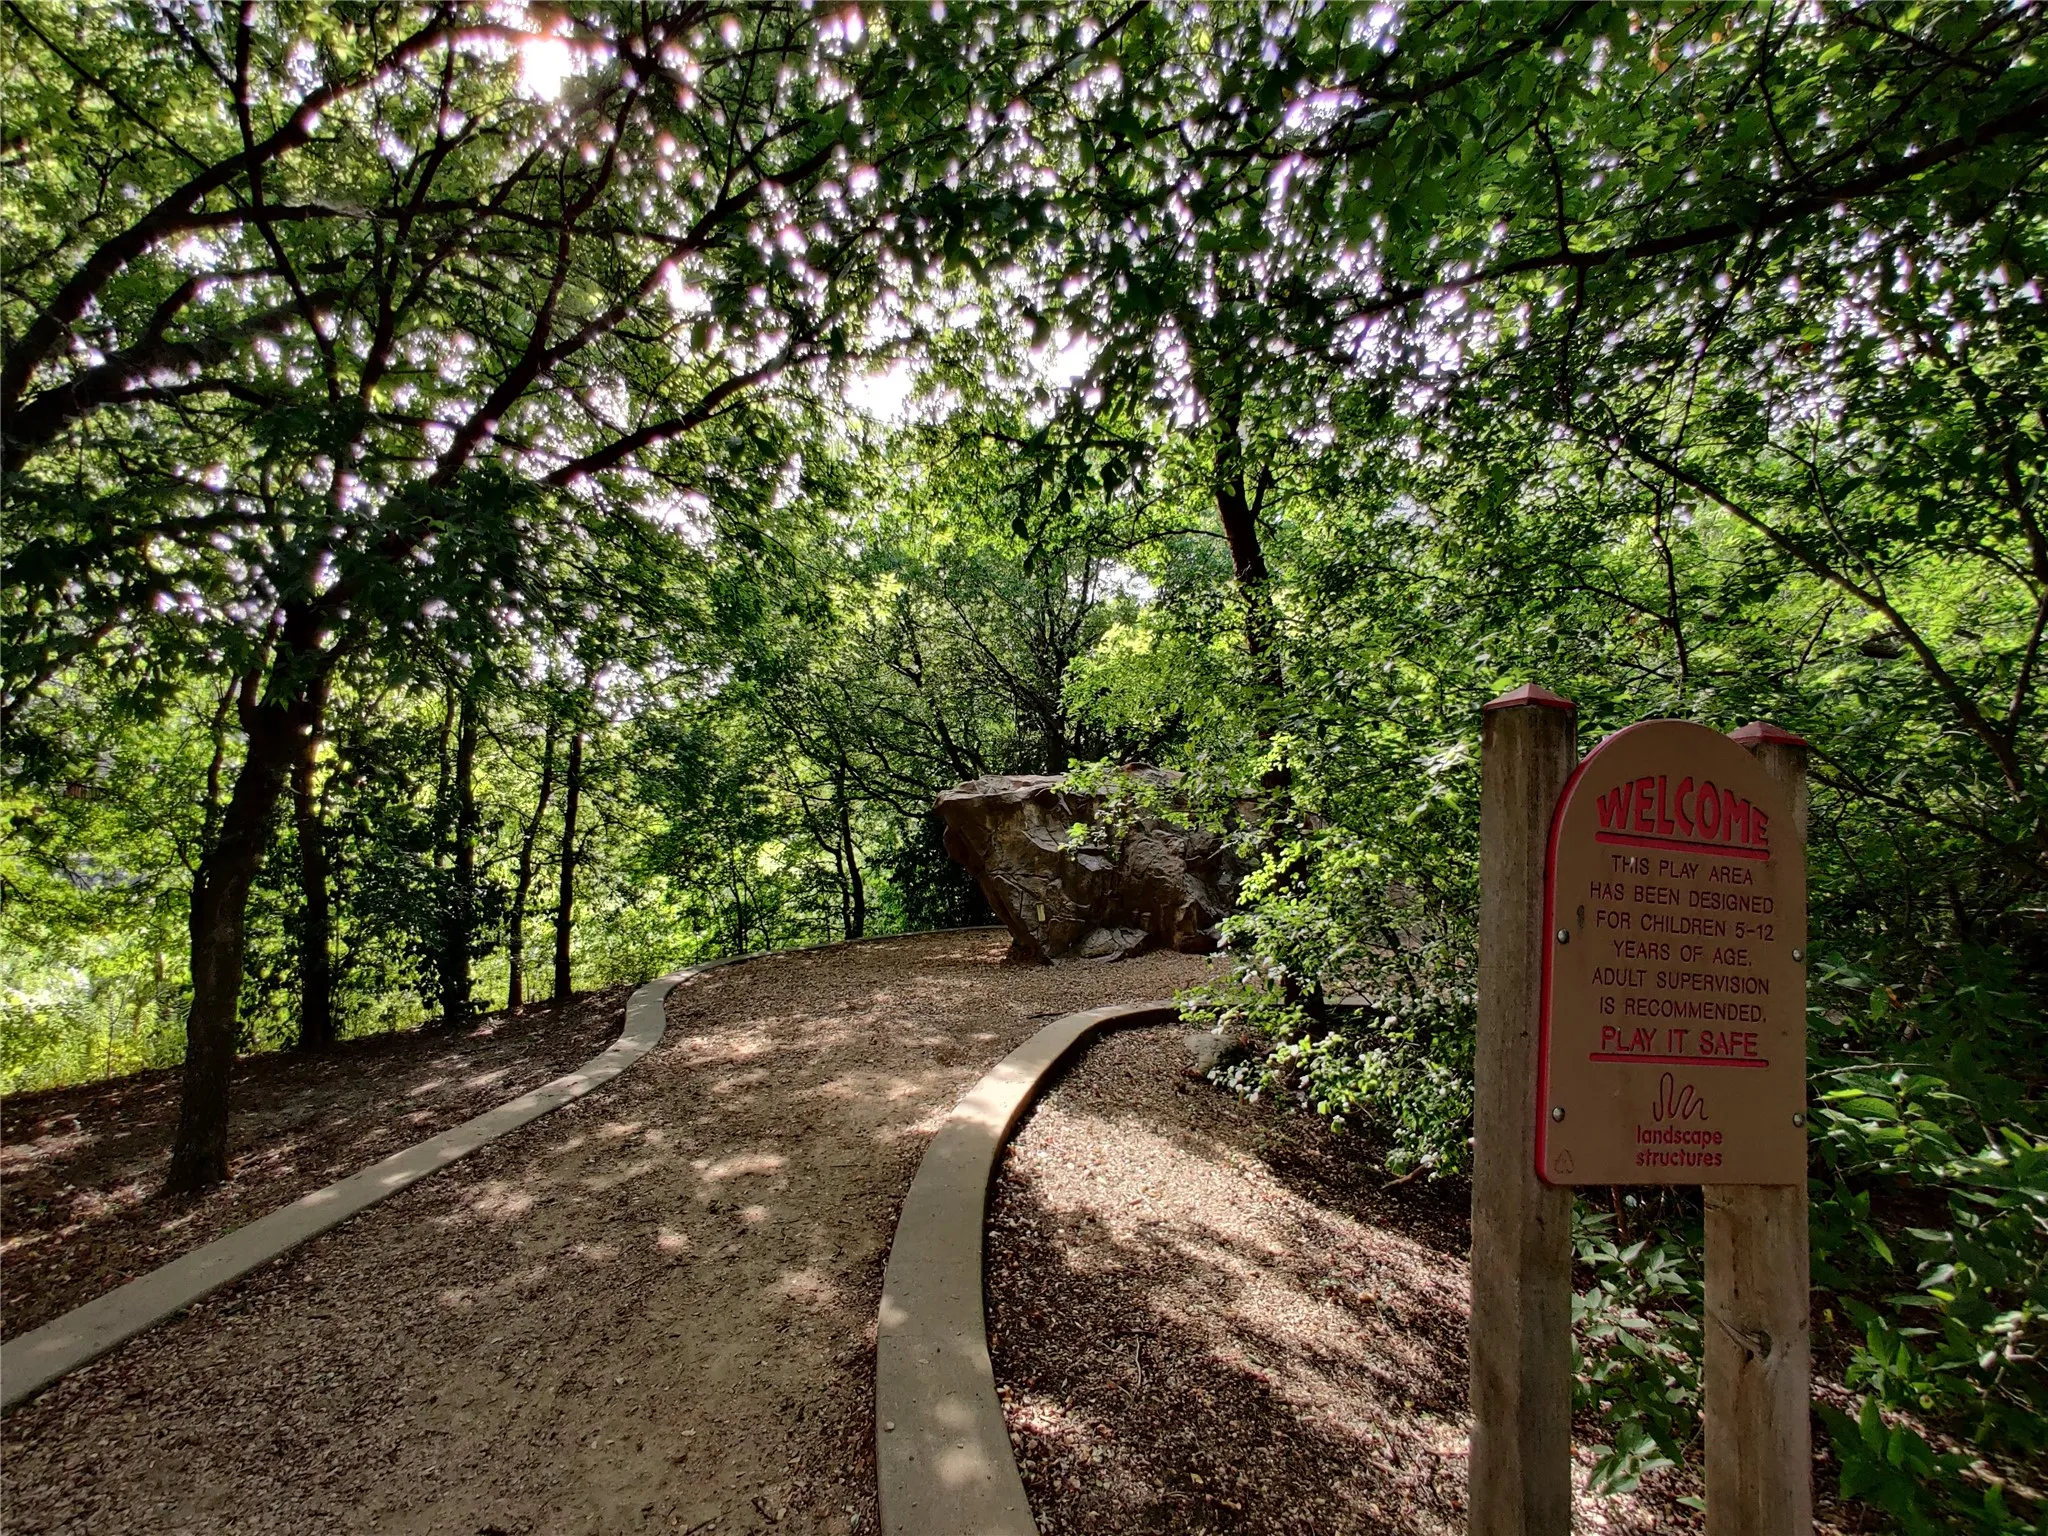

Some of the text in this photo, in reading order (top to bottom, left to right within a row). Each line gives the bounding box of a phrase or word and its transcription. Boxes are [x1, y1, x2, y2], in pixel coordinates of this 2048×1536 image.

[1596, 775, 1769, 846] WELCOME
[1611, 855, 1753, 885] THIS PLAY AREA
[1590, 882, 1774, 914] HAS BEEN DESIGNED
[1596, 910, 1774, 941] FOR CHILDREN 5-12
[1613, 940, 1752, 966] YEARS OF AGE.
[1592, 967, 1770, 995] ADULT SUPERVISION
[1600, 996, 1767, 1023] IS RECOMMENDED.
[1601, 1026, 1758, 1057] PLAY IT SAFE
[1636, 1125, 1722, 1149] landscape
[1636, 1149, 1722, 1168] structures
